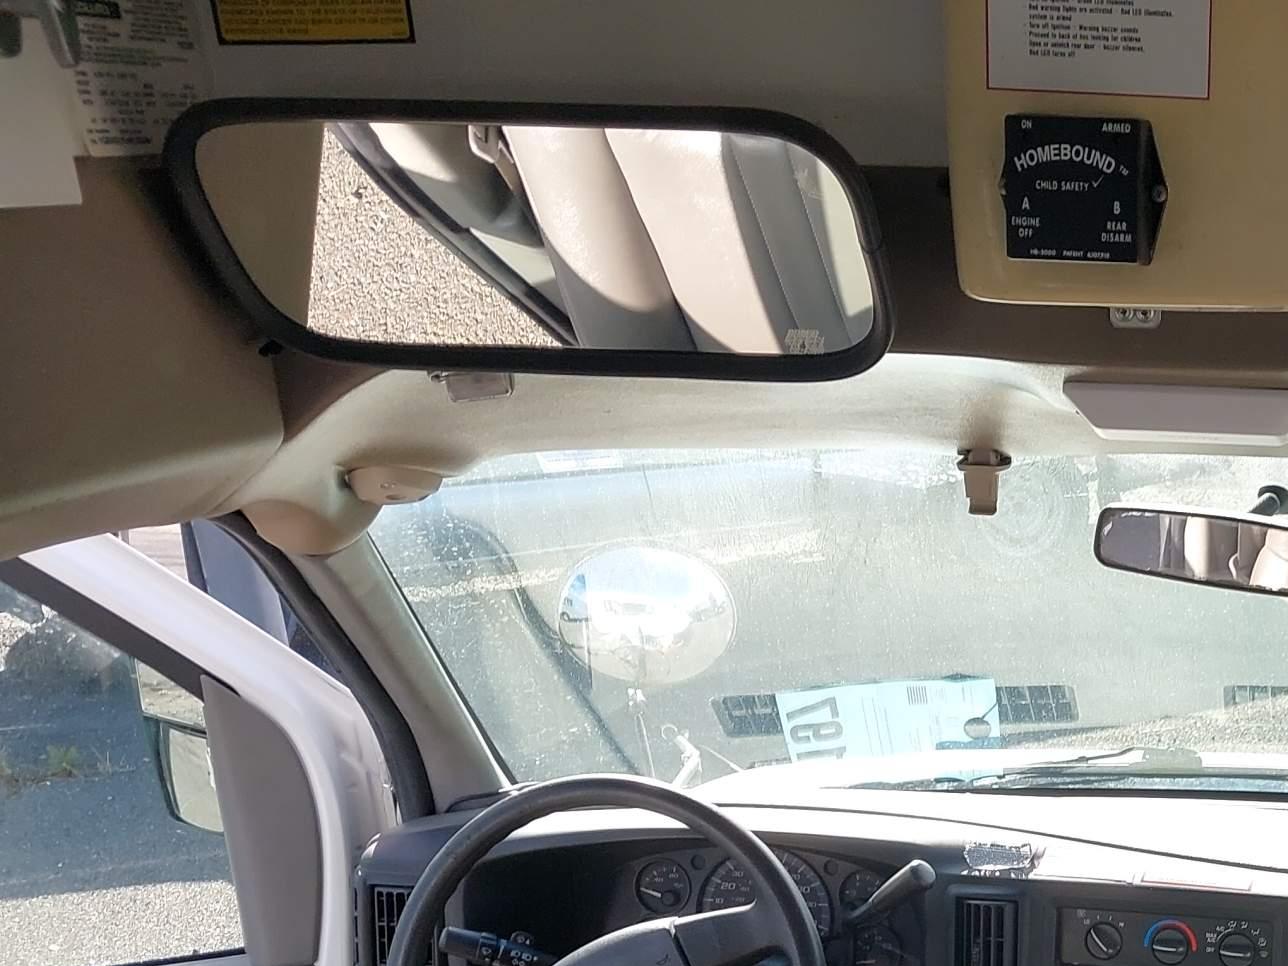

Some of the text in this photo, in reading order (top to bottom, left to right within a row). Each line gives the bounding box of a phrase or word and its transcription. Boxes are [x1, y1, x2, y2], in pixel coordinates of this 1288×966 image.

[1021, 120, 1032, 129] ON
[1101, 122, 1131, 133] ARMED
[1013, 143, 1116, 174] HOMEBOUND
[1035, 180, 1089, 192] CHILD SAFETY
[1021, 196, 1030, 210] A
[1113, 201, 1121, 214] B
[1011, 216, 1040, 228] ENGINE
[1106, 221, 1127, 231] REAR
[1018, 228, 1033, 238] OFF
[1101, 232, 1132, 243] DISARM
[720, 881, 736, 890] 20
